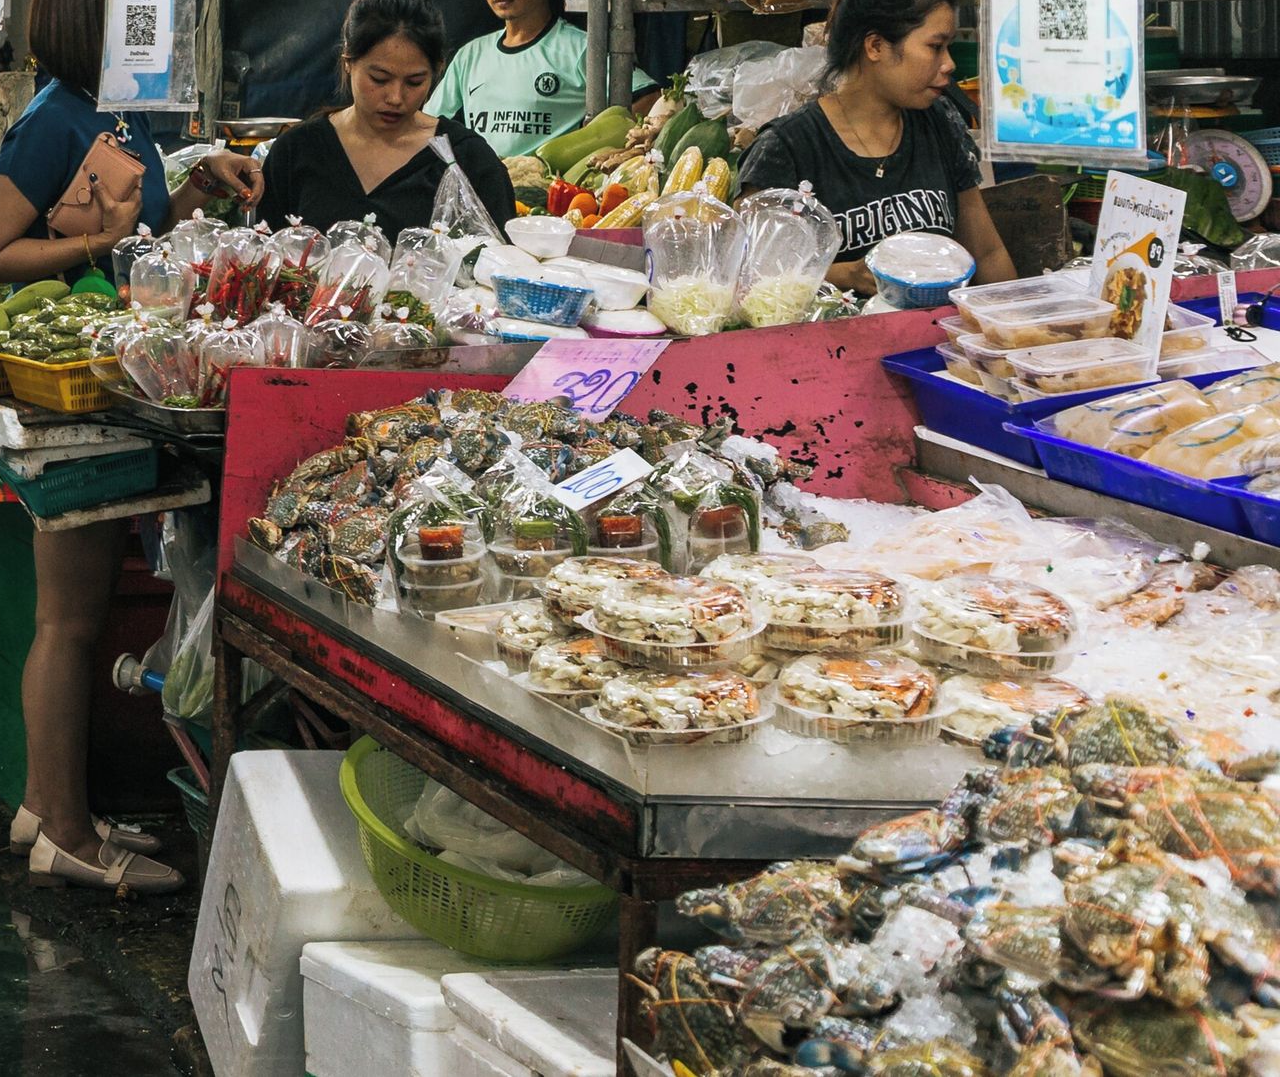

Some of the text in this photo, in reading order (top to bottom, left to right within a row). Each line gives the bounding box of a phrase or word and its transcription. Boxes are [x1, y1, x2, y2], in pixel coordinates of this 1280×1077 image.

[493, 110, 553, 123] INFINITE
[491, 122, 553, 136] ATHLETE
[561, 462, 623, 500] 100
